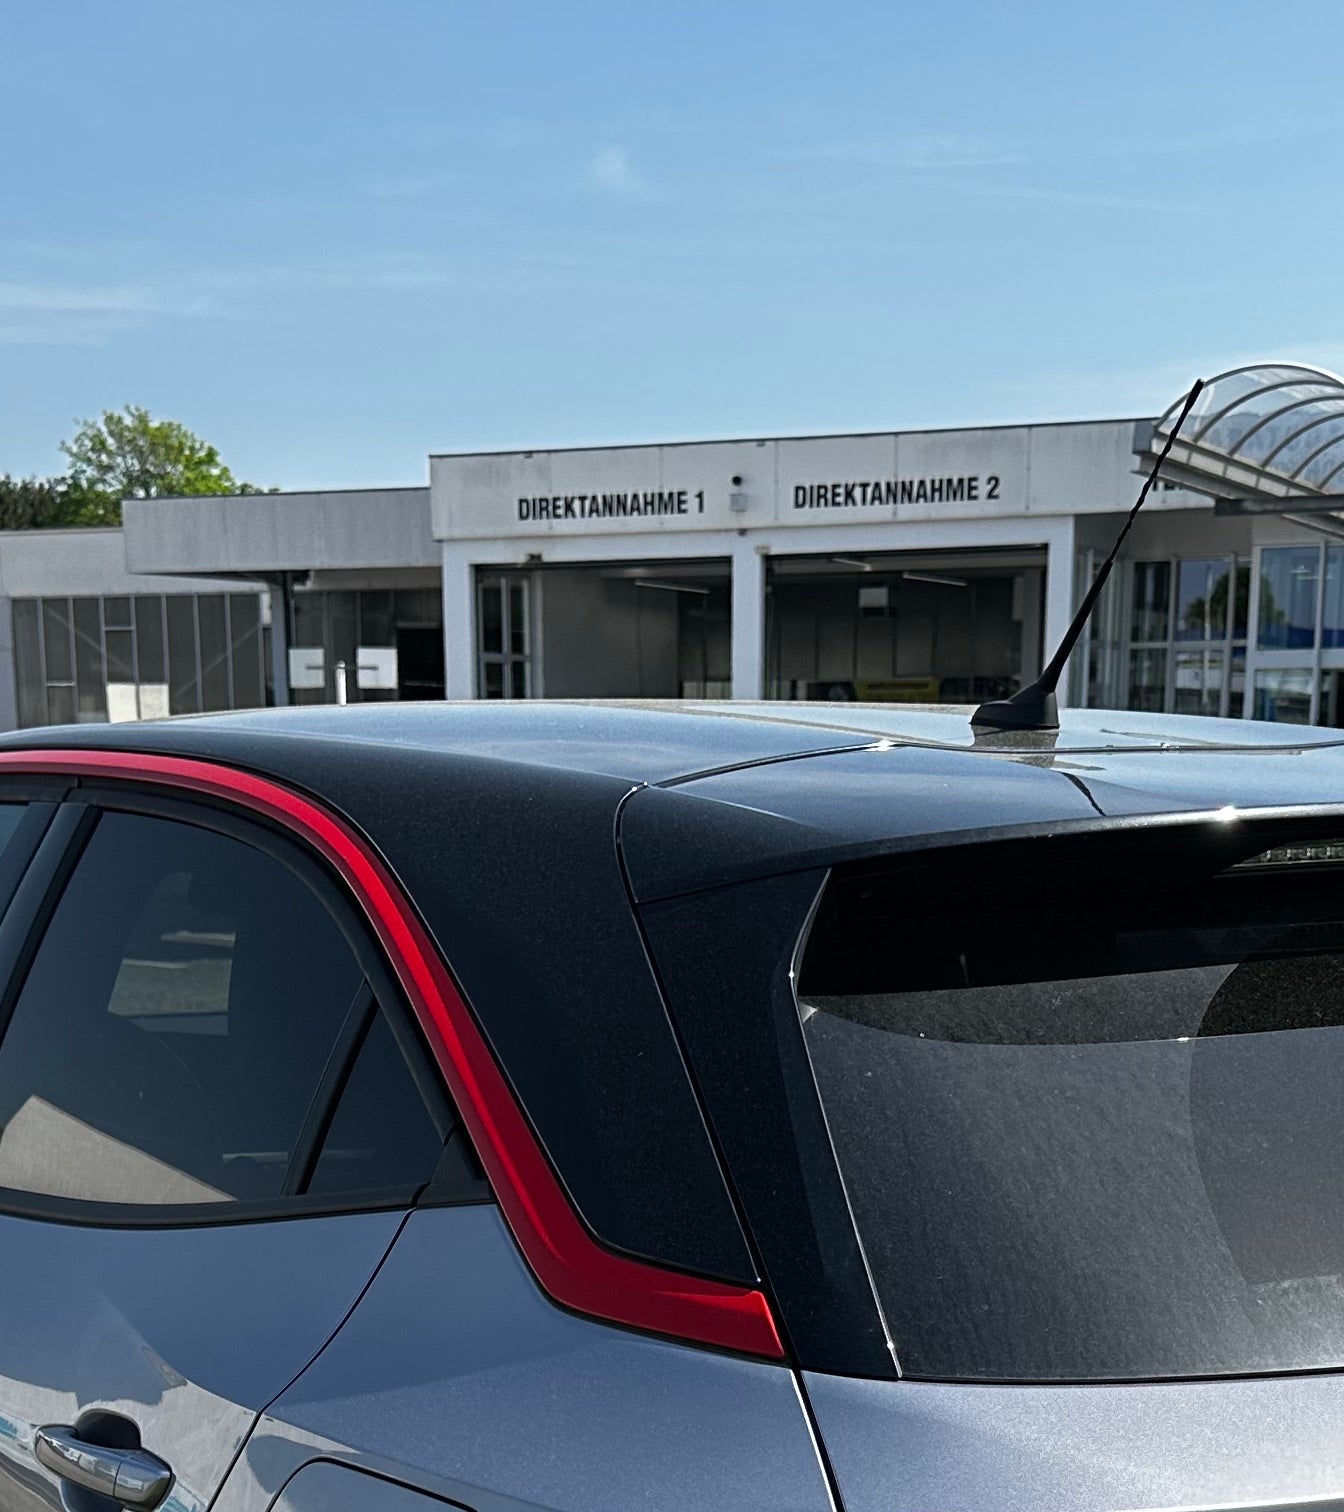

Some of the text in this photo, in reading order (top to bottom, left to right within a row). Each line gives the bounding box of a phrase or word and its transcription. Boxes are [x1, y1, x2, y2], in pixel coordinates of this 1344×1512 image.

[518, 491, 705, 521] DIREKTANNAHME 1
[794, 476, 1001, 509] DIREKTANNAHME 2
